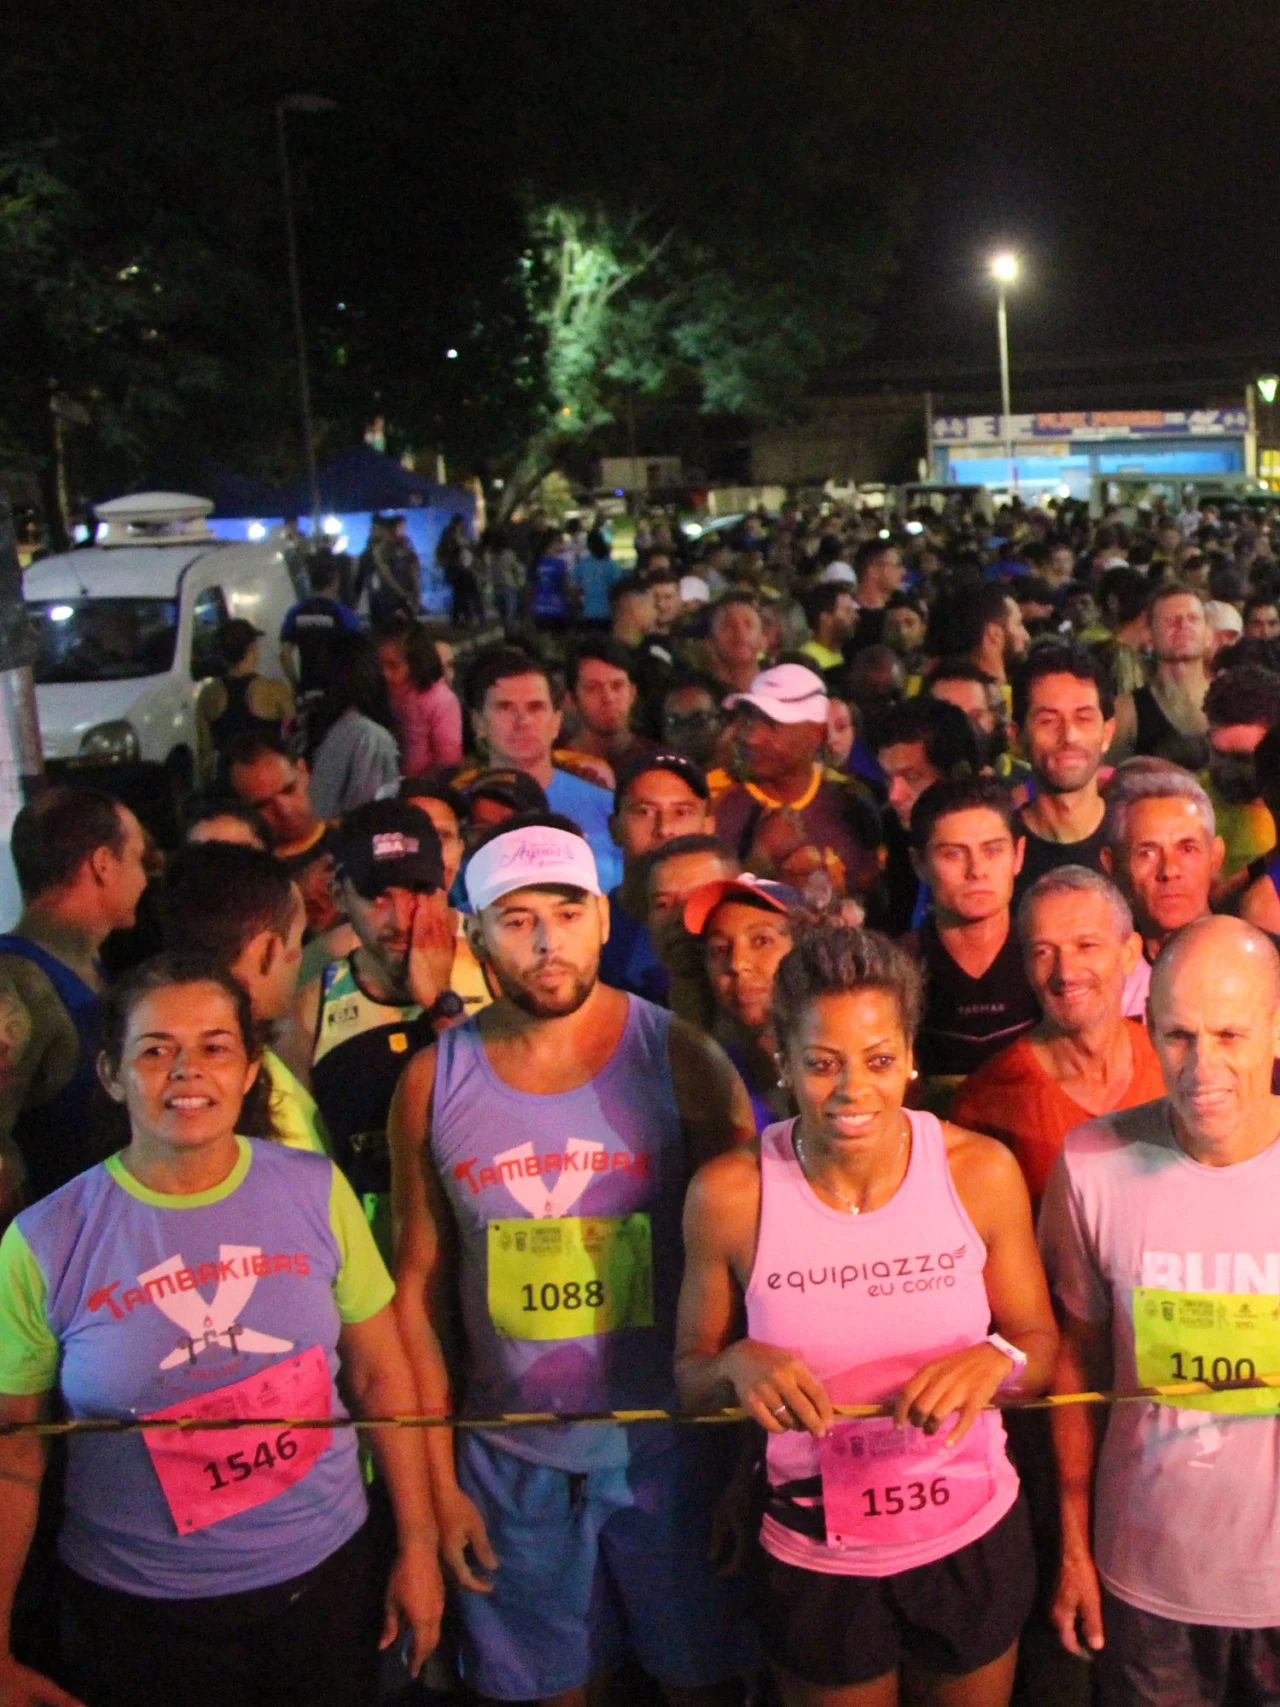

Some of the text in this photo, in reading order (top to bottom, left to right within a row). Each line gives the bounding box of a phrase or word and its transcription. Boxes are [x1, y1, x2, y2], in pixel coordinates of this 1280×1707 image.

[453, 1151, 650, 1195] TAMBAKIBAS
[87, 1253, 310, 1320] TAMBAKIBAS
[767, 1252, 955, 1293] equipiazza
[867, 1274, 956, 1298] eu corro
[522, 1280, 605, 1312] 1088
[1170, 1352, 1256, 1384] 1100
[203, 1430, 298, 1492] 1546
[861, 1476, 950, 1517] 1536
